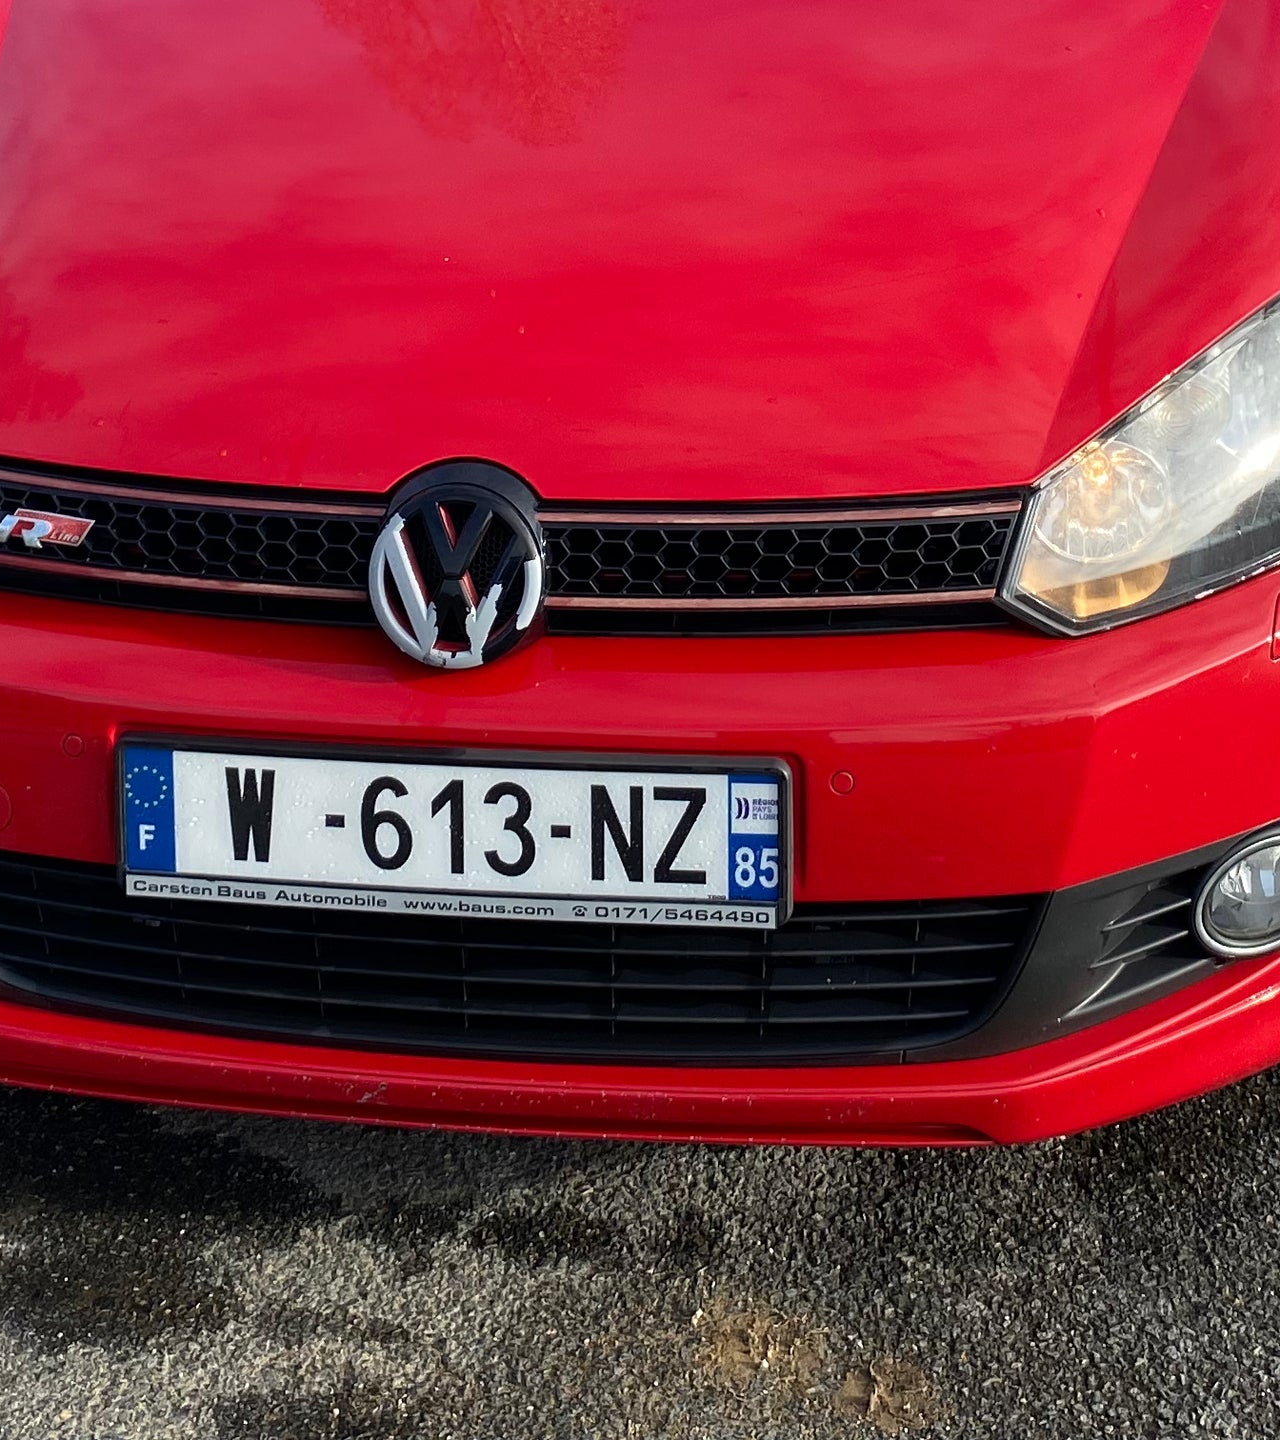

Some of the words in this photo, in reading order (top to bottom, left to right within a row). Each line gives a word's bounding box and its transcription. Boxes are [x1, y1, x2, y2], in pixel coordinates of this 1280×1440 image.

[50, 529, 80, 543] Line
[138, 824, 155, 850] F
[734, 846, 778, 889] 85
[132, 879, 213, 897] Carsten
[217, 885, 267, 901] Baus
[274, 889, 388, 908] Automobile
[403, 897, 555, 916] www.baus.com
[594, 905, 770, 923] 0171/5464490
